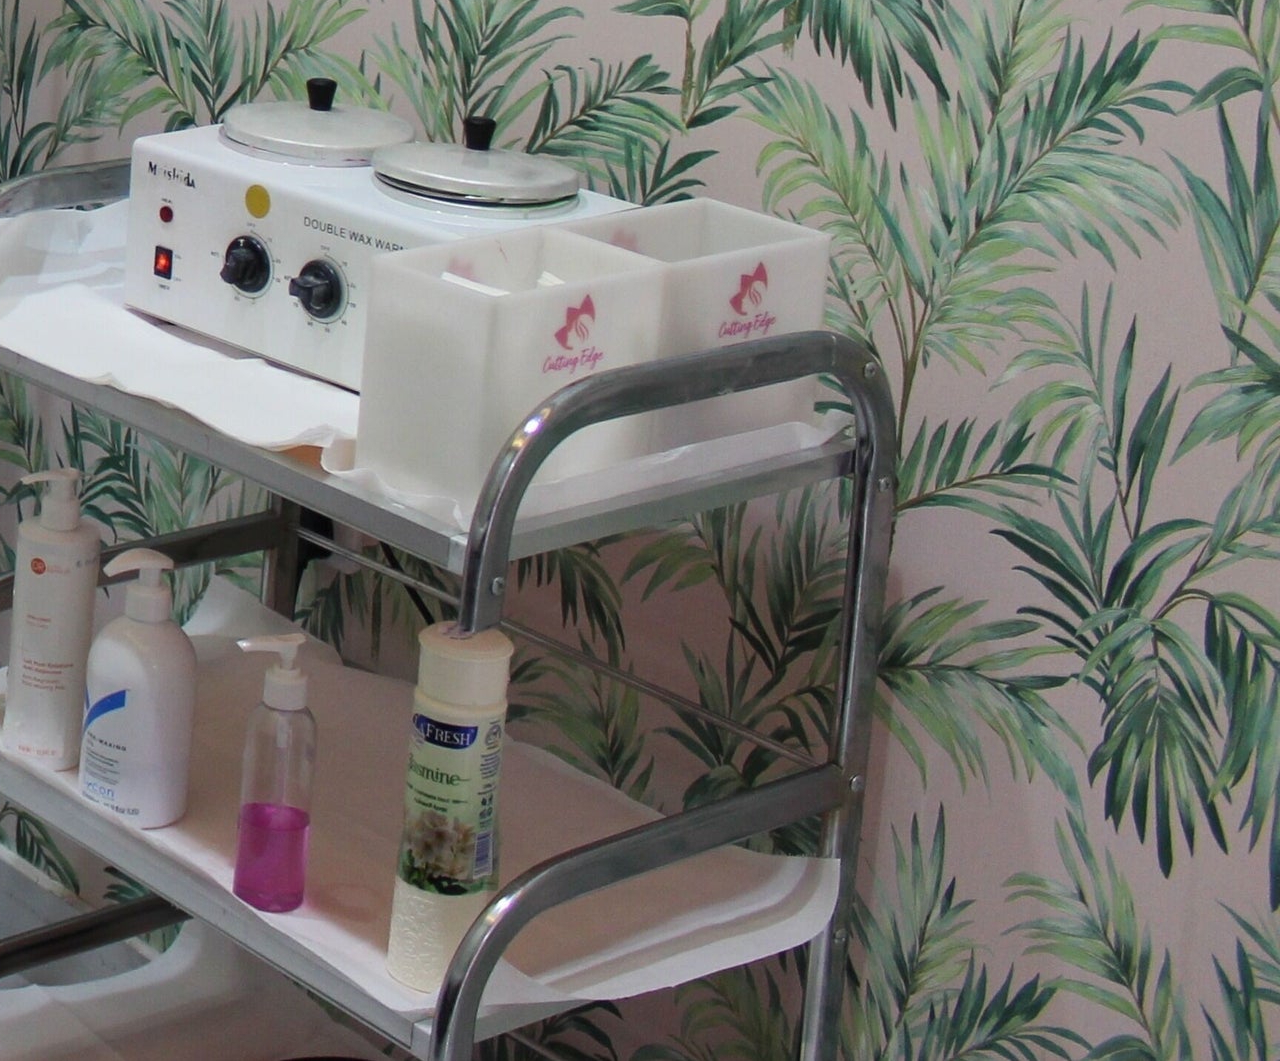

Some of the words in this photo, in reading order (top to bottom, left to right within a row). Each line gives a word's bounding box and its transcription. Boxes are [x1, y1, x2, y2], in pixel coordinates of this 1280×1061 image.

[303, 216, 346, 239] DOUBLE
[348, 230, 373, 247] WAX
[543, 356, 578, 374] Cutting
[579, 346, 603, 370] Edge
